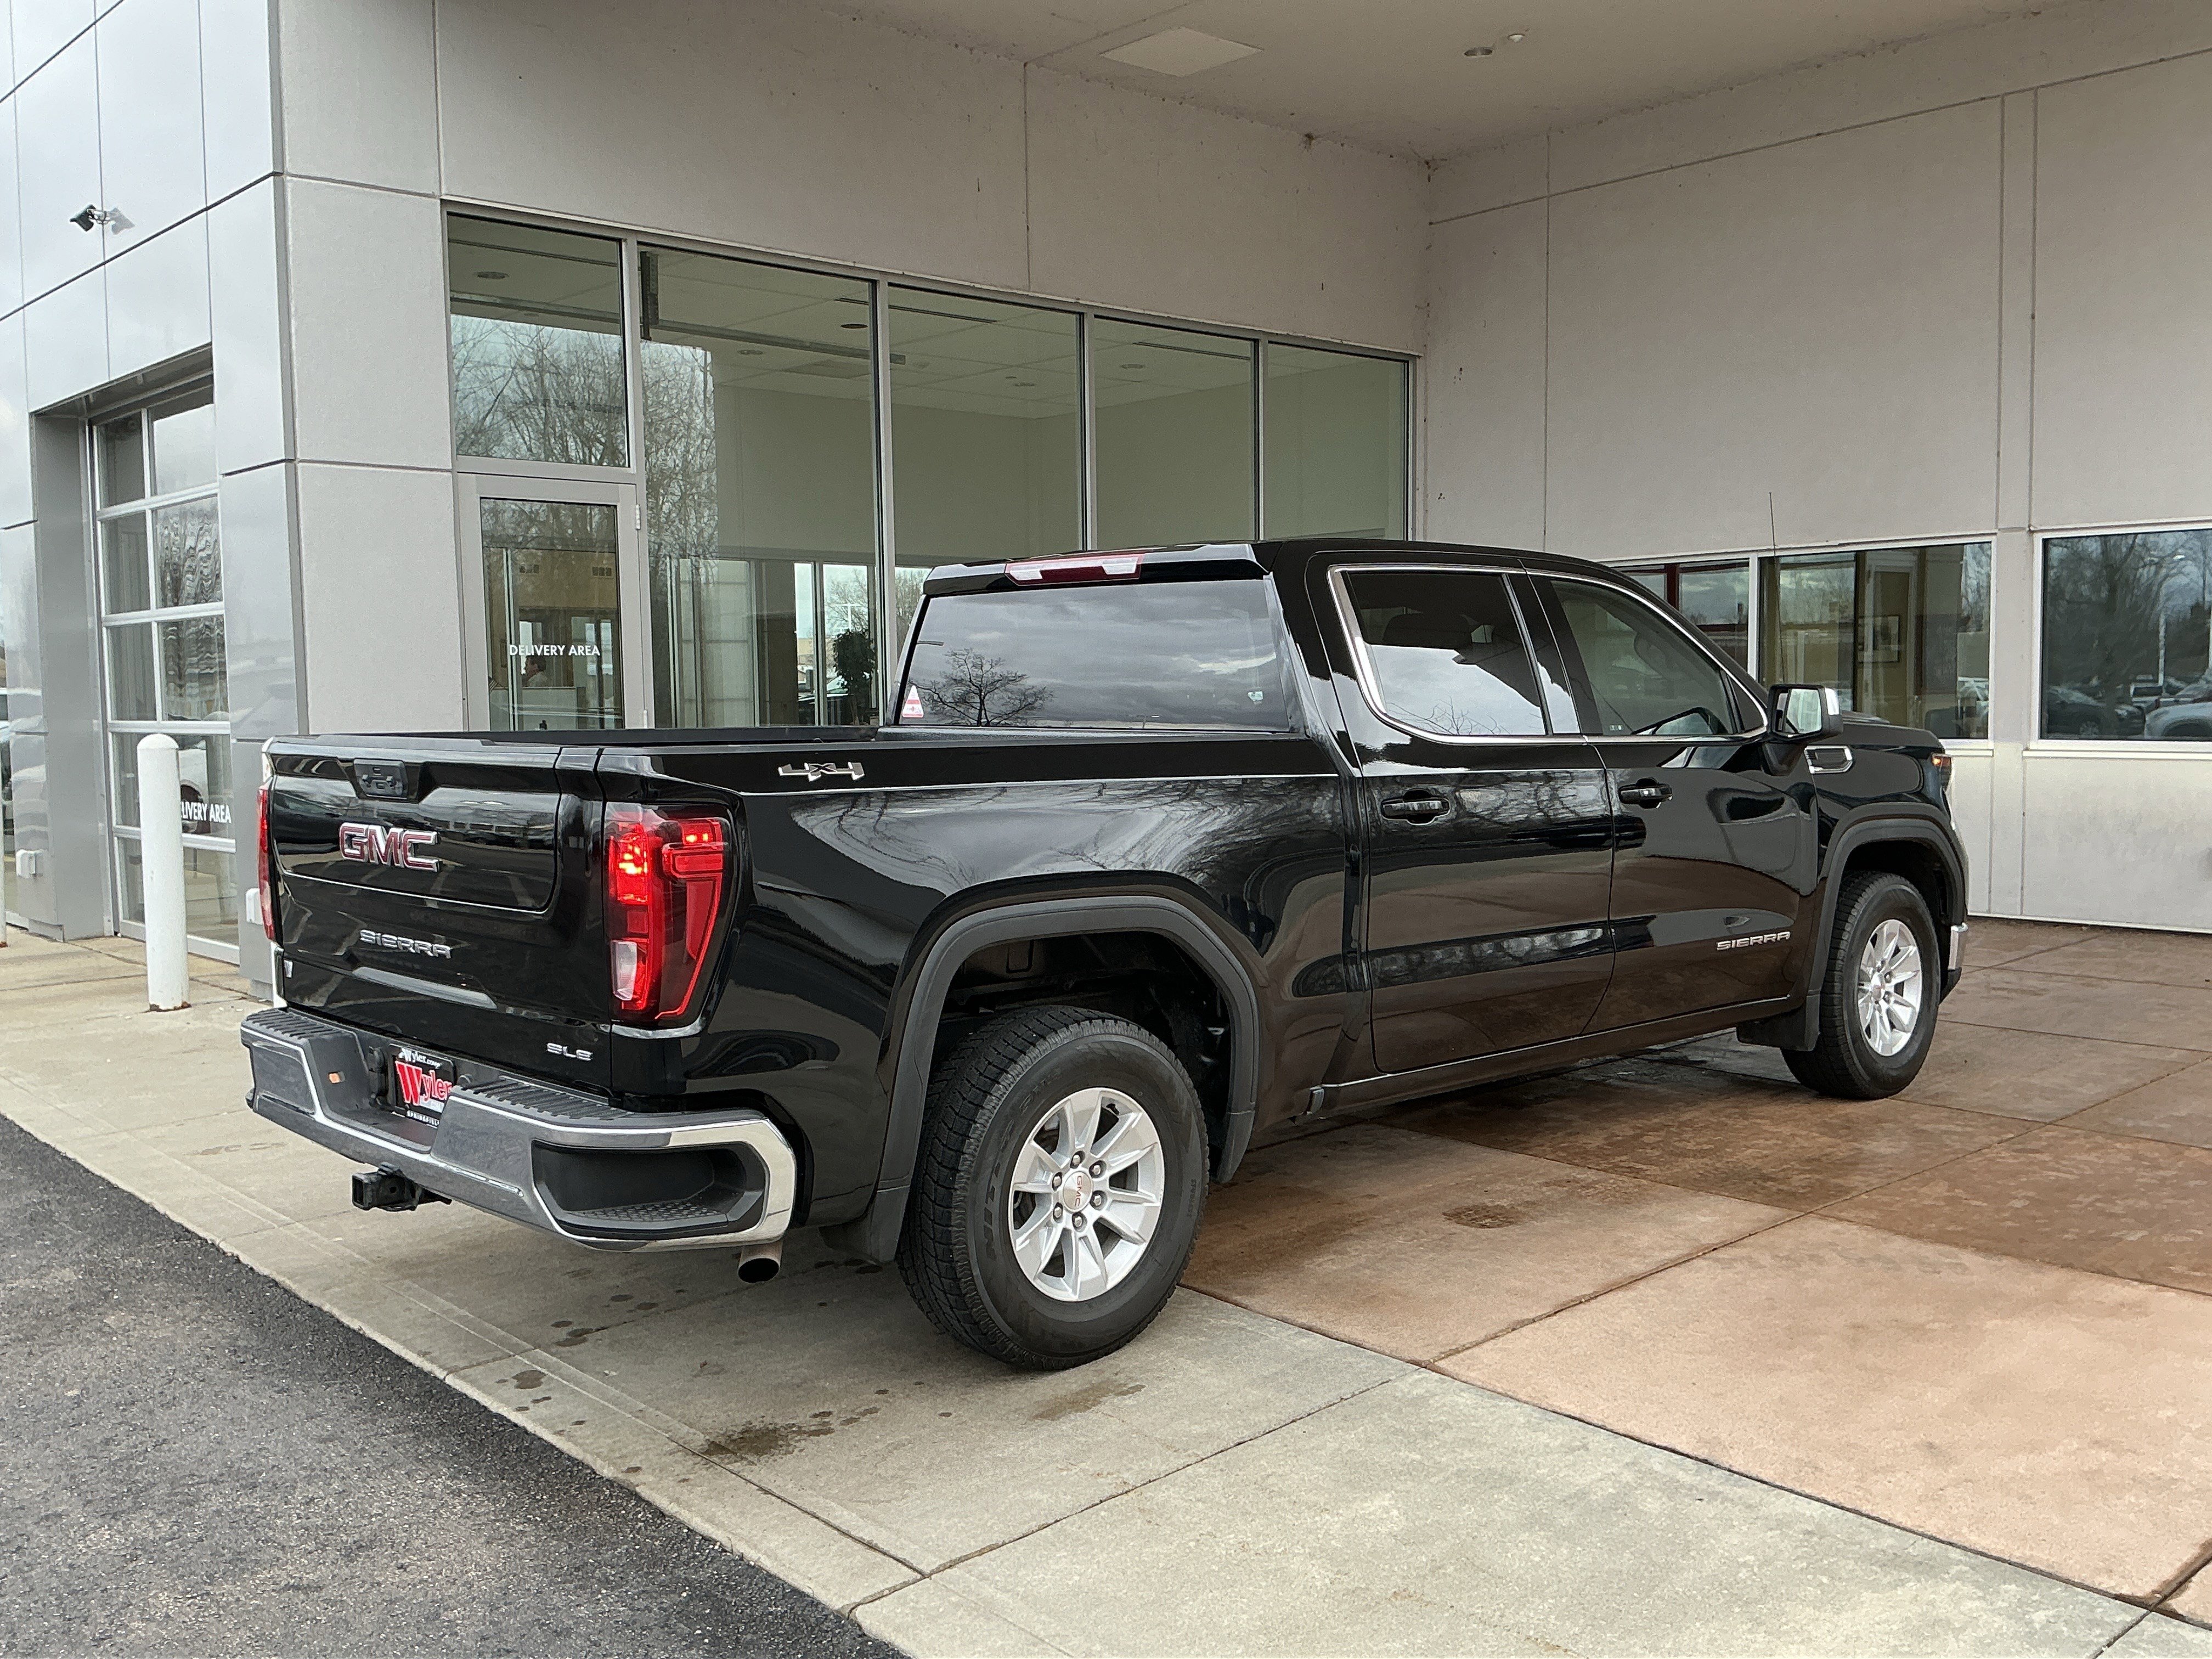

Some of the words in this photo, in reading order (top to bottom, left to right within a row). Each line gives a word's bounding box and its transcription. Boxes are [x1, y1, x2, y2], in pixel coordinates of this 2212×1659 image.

[510, 645, 566, 656] DELIVERY
[568, 645, 601, 656] AREA
[181, 801, 208, 821] LIVERY
[208, 803, 232, 823] AREA
[339, 822, 441, 872] GMC
[359, 929, 452, 959] SIERRA
[1717, 931, 1791, 951] SIERRA
[547, 1043, 593, 1061] SLE
[395, 1060, 453, 1107] Wyler
